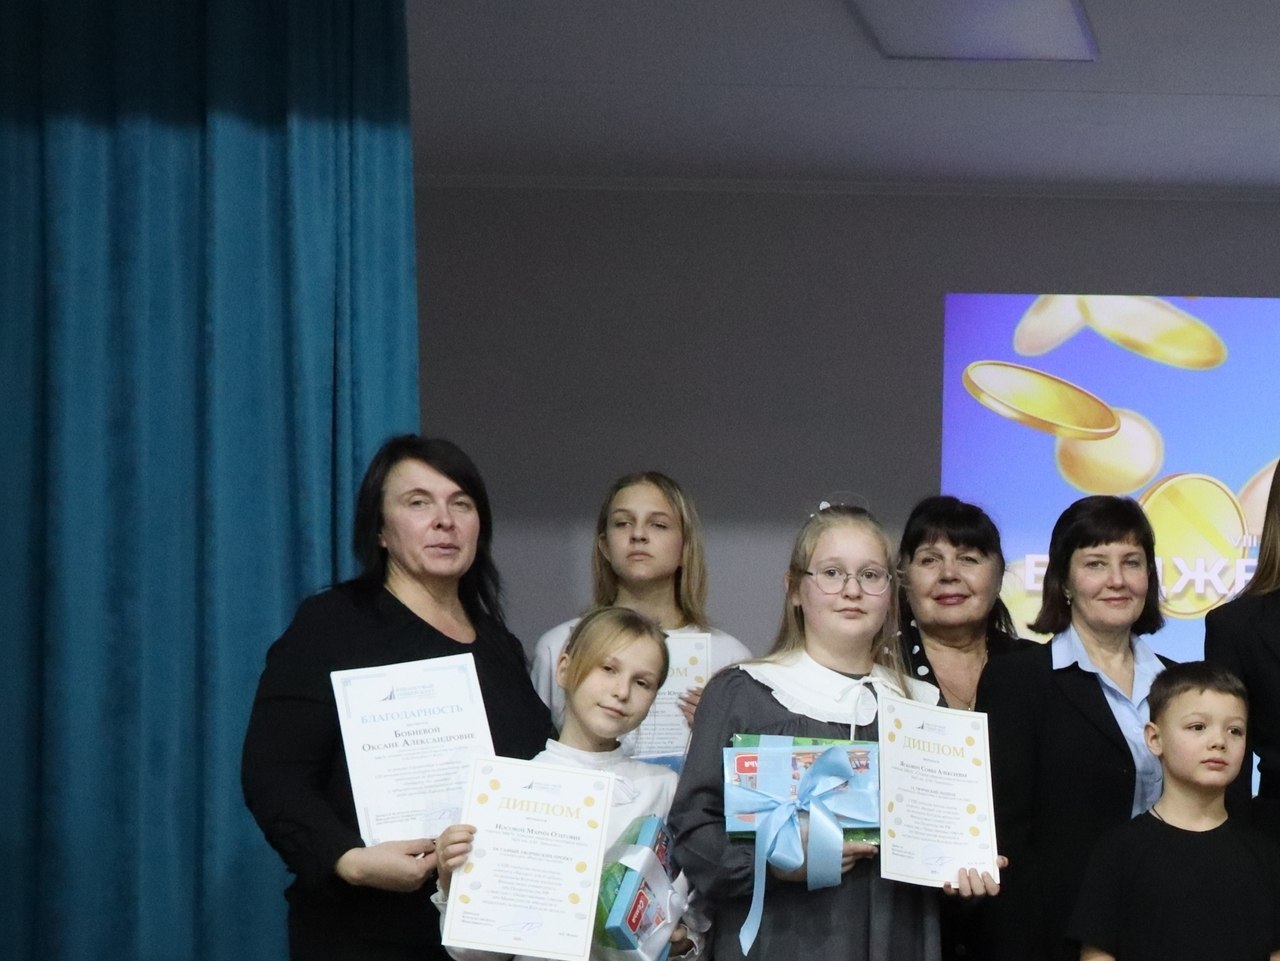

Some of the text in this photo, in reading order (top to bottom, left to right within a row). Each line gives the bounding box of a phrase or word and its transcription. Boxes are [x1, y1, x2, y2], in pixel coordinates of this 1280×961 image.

[361, 704, 463, 724] БЛАГОДАРНОСТЬ
[903, 736, 966, 758] ДИПЛОМ
[498, 797, 582, 818] ДИПЛОМ
